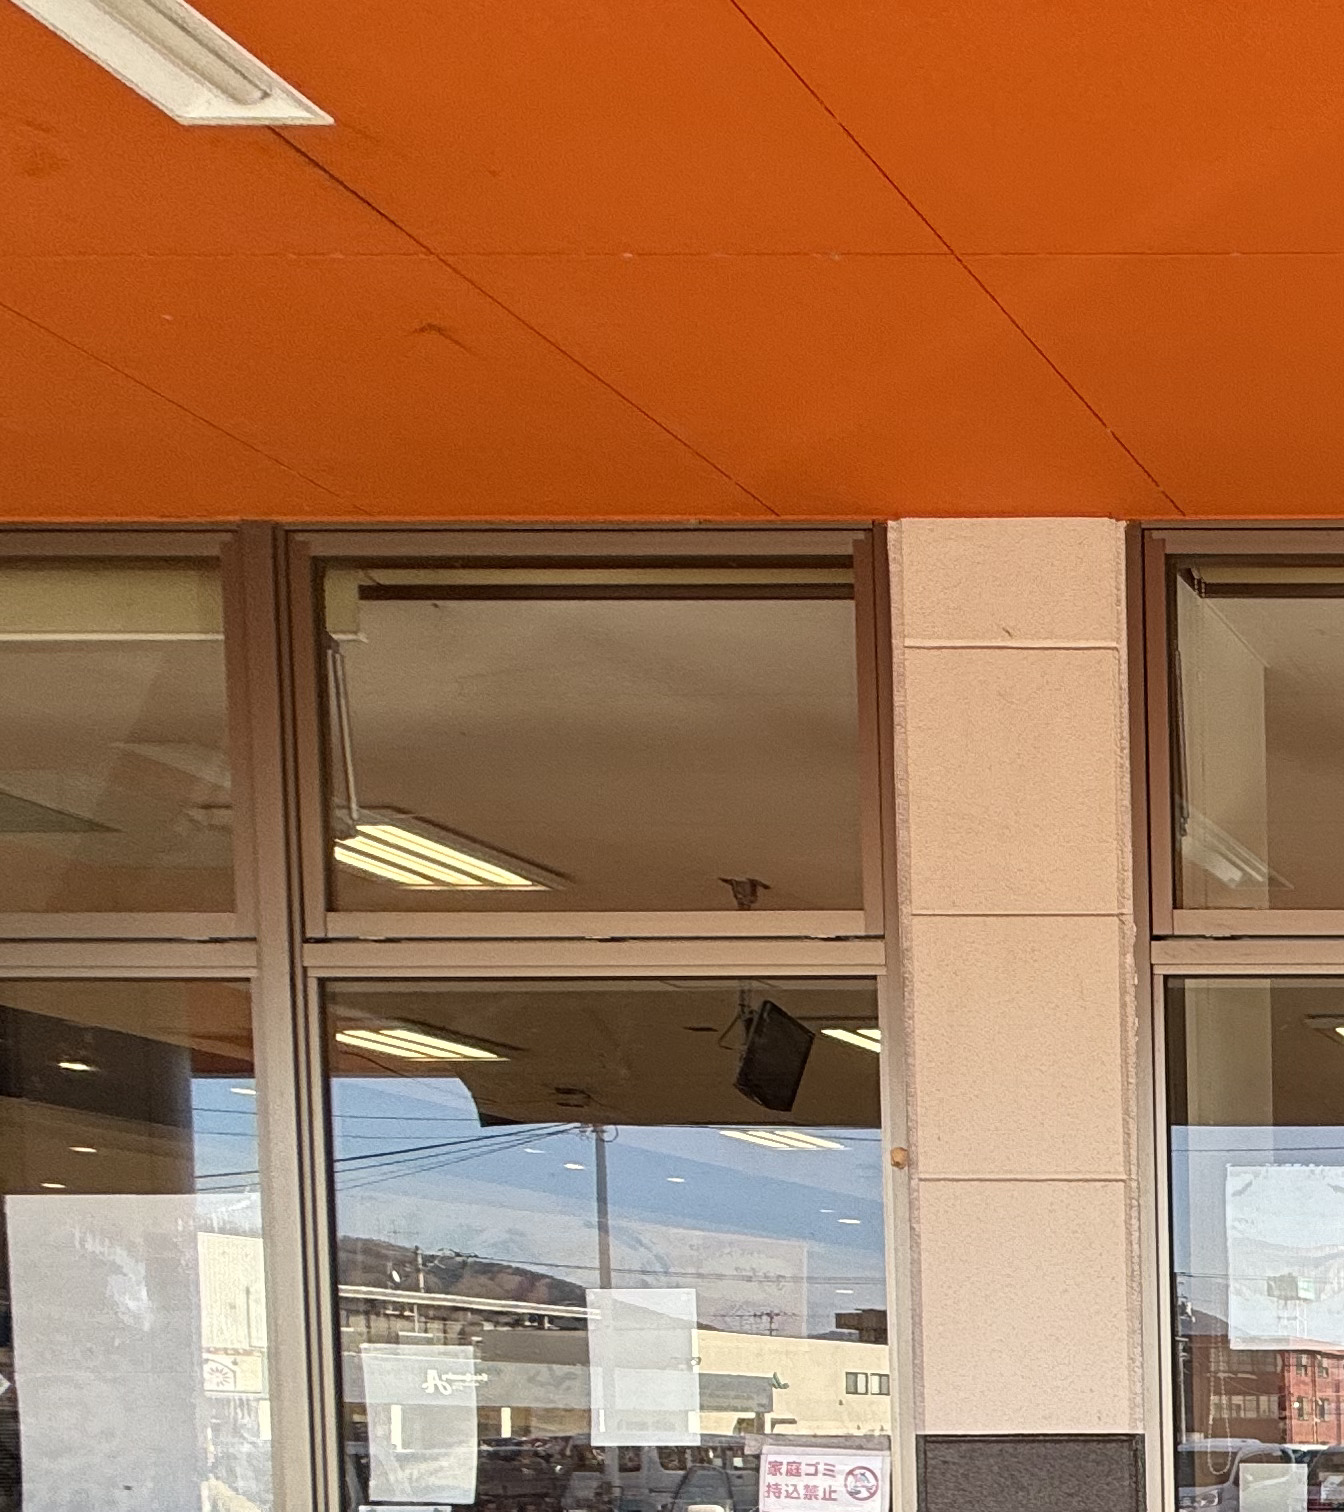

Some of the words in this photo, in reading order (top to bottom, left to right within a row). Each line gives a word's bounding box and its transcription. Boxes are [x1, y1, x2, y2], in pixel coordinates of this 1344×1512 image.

[766, 1460, 837, 1478] 家庭ゴミ
[764, 1482, 839, 1502] 持込禁止
